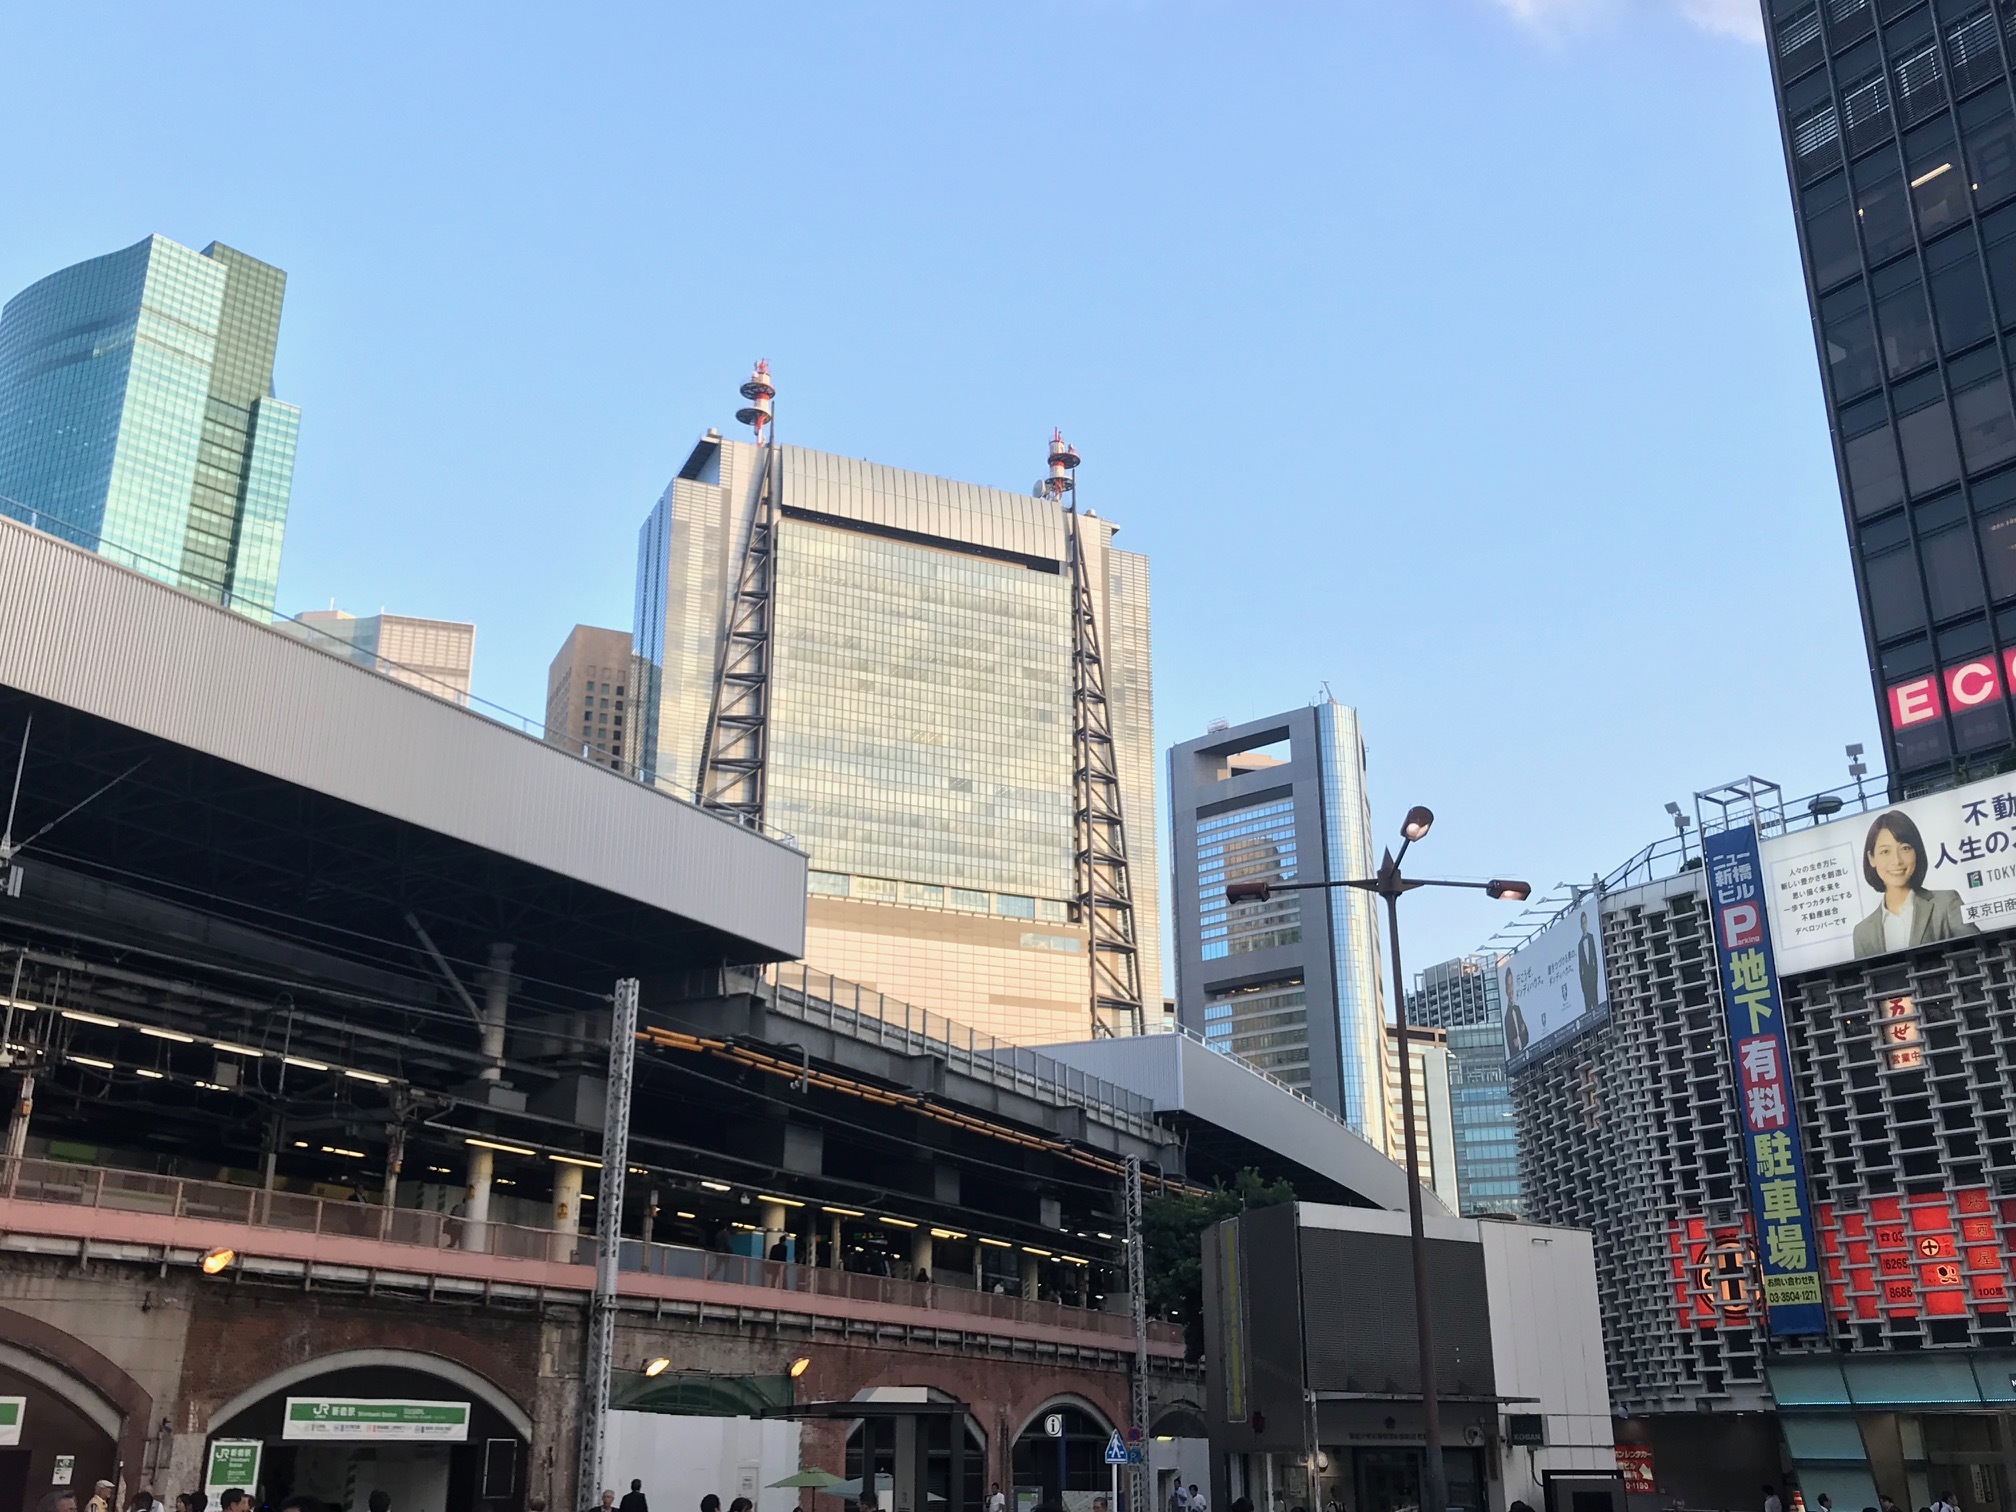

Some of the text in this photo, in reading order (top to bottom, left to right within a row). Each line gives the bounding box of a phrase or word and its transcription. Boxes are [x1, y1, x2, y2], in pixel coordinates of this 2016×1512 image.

[1896, 654, 2016, 725] EC
[1713, 852, 1750, 871] ニュー
[1789, 857, 1838, 877] 人々の生き方に
[1715, 862, 1753, 888] 新橋
[1781, 867, 1849, 891] 新しい豊かさを創造し
[1718, 882, 1755, 904] ビル
[1792, 881, 1841, 900] 思い描く未来を
[1783, 891, 1852, 913] 一歩ずつカタチにする
[1801, 906, 1839, 922] 不動産総合
[1892, 1050, 1921, 1065] 営業中
